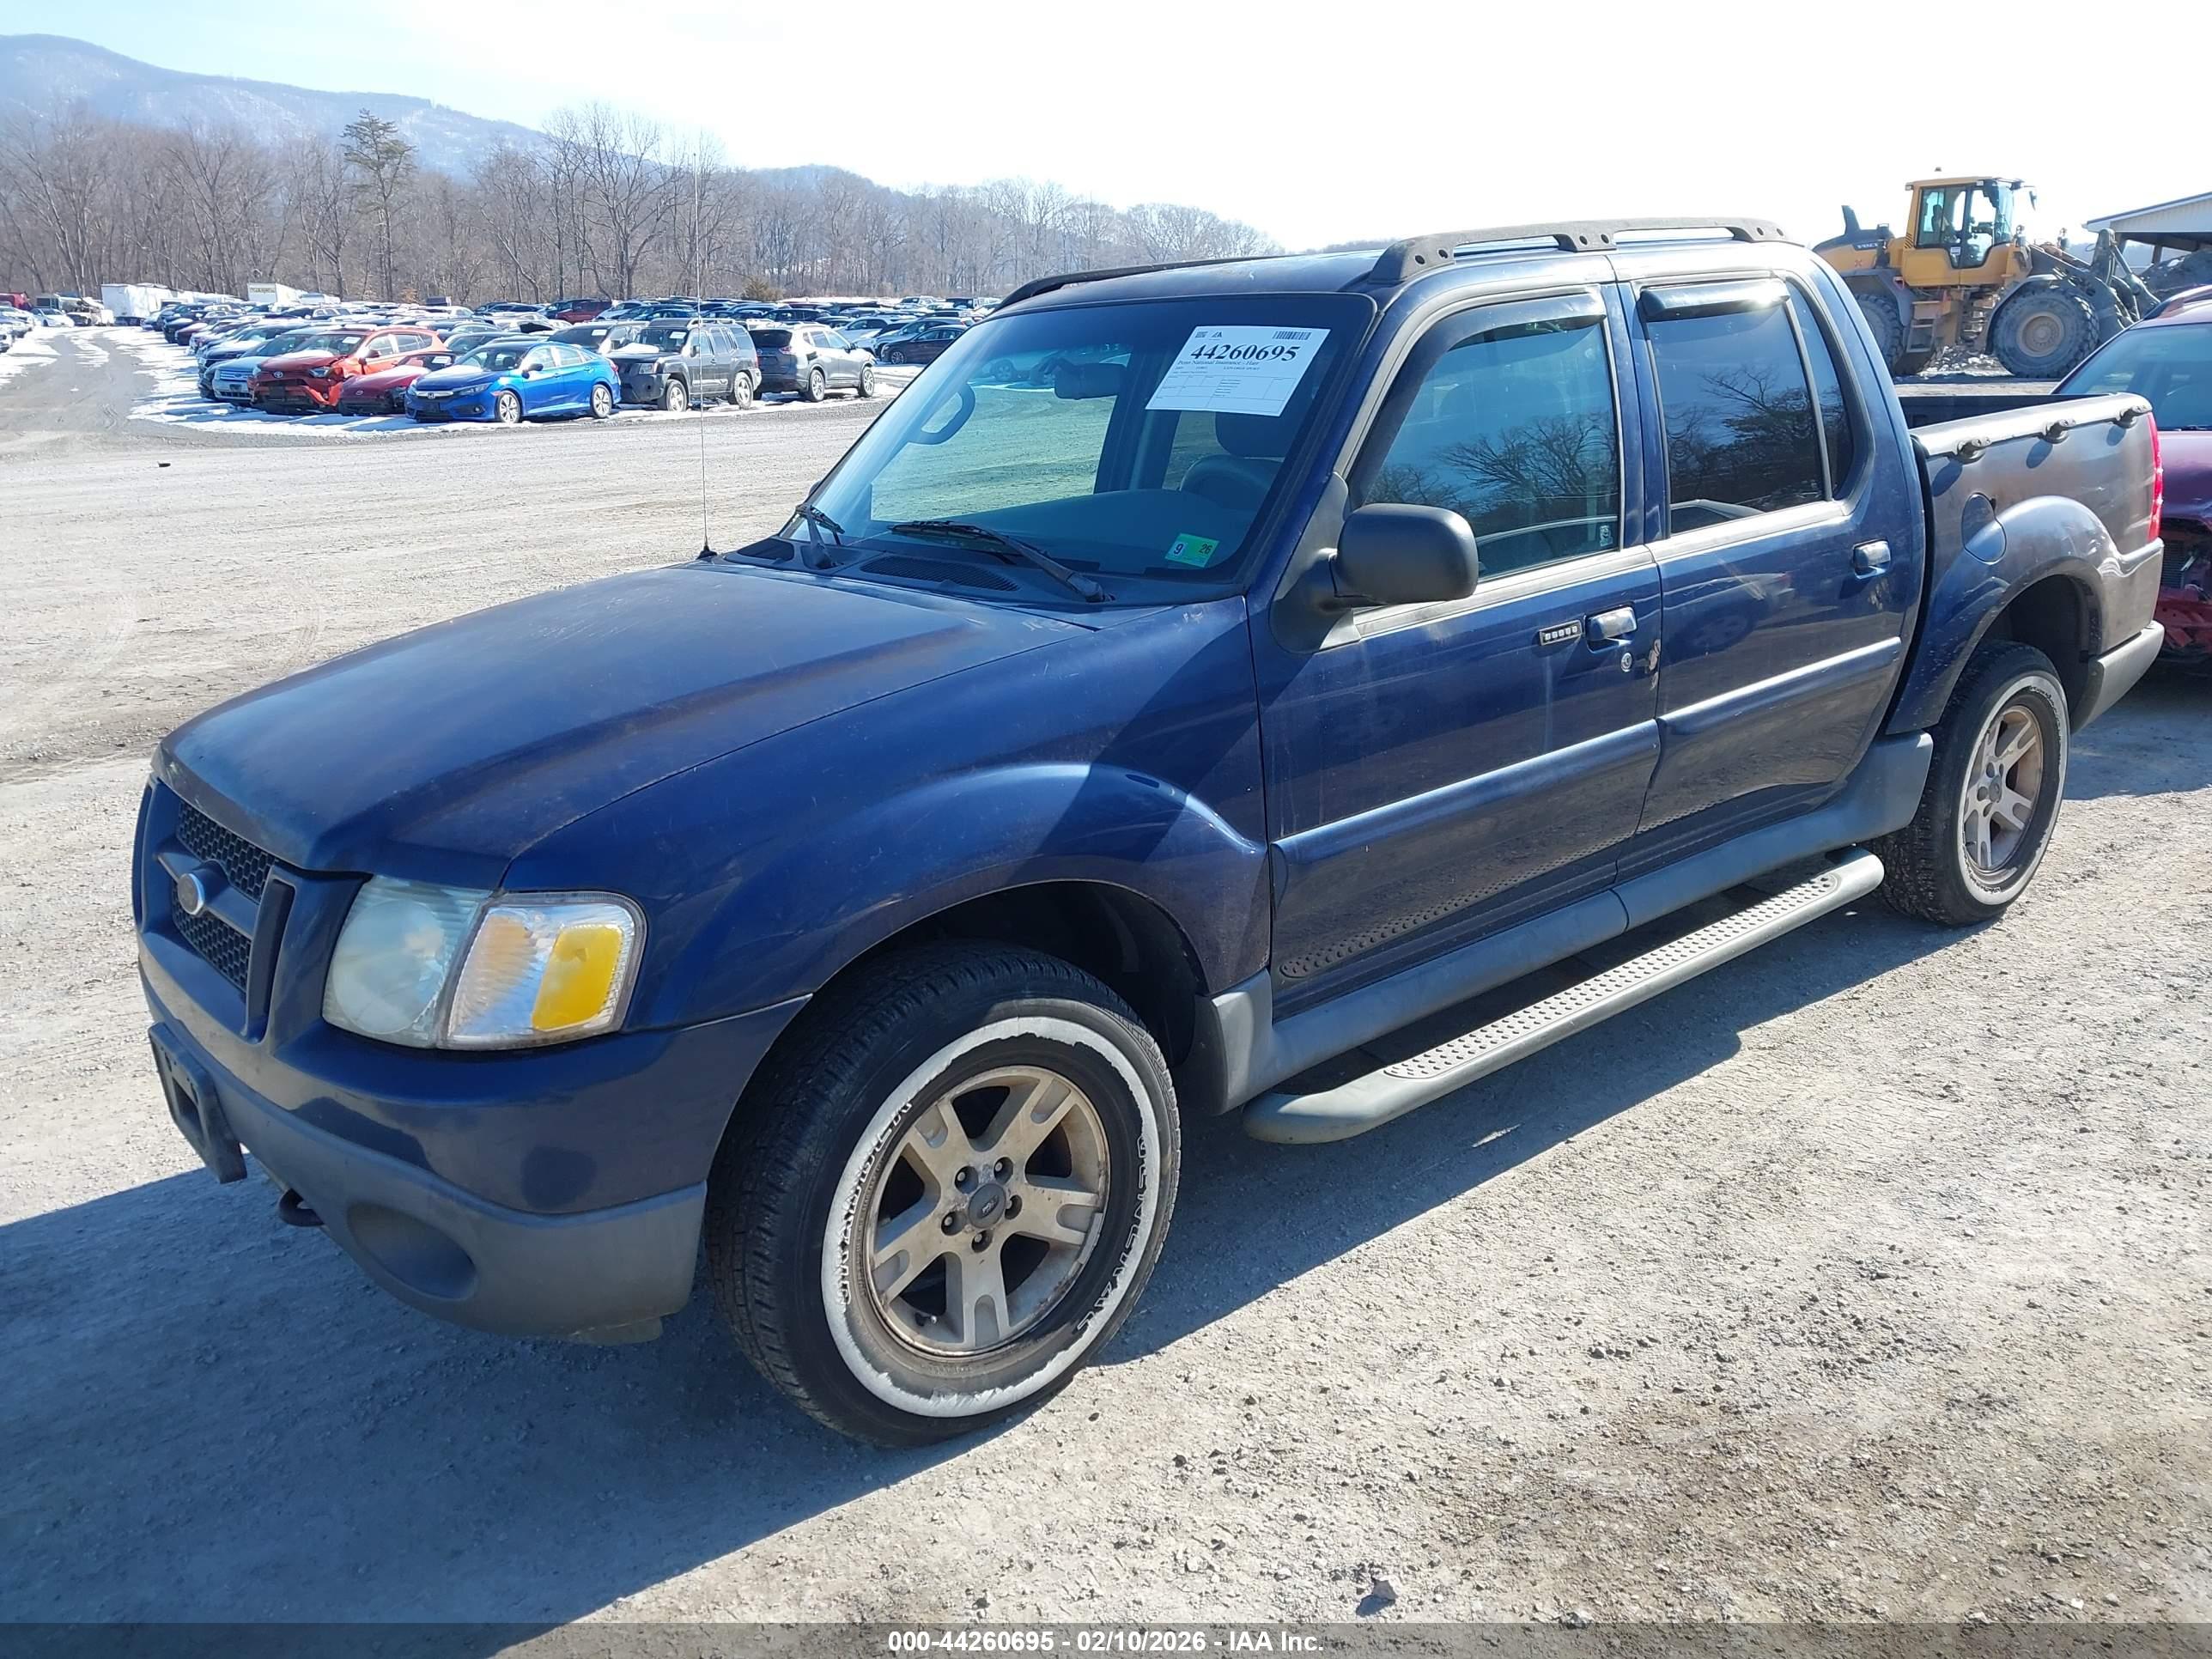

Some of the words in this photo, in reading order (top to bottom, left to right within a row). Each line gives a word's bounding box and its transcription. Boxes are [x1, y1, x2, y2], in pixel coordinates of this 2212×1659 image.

[1190, 344, 1300, 362] 44260695
[1173, 543, 1184, 555] 9
[1199, 543, 1213, 555] 26
